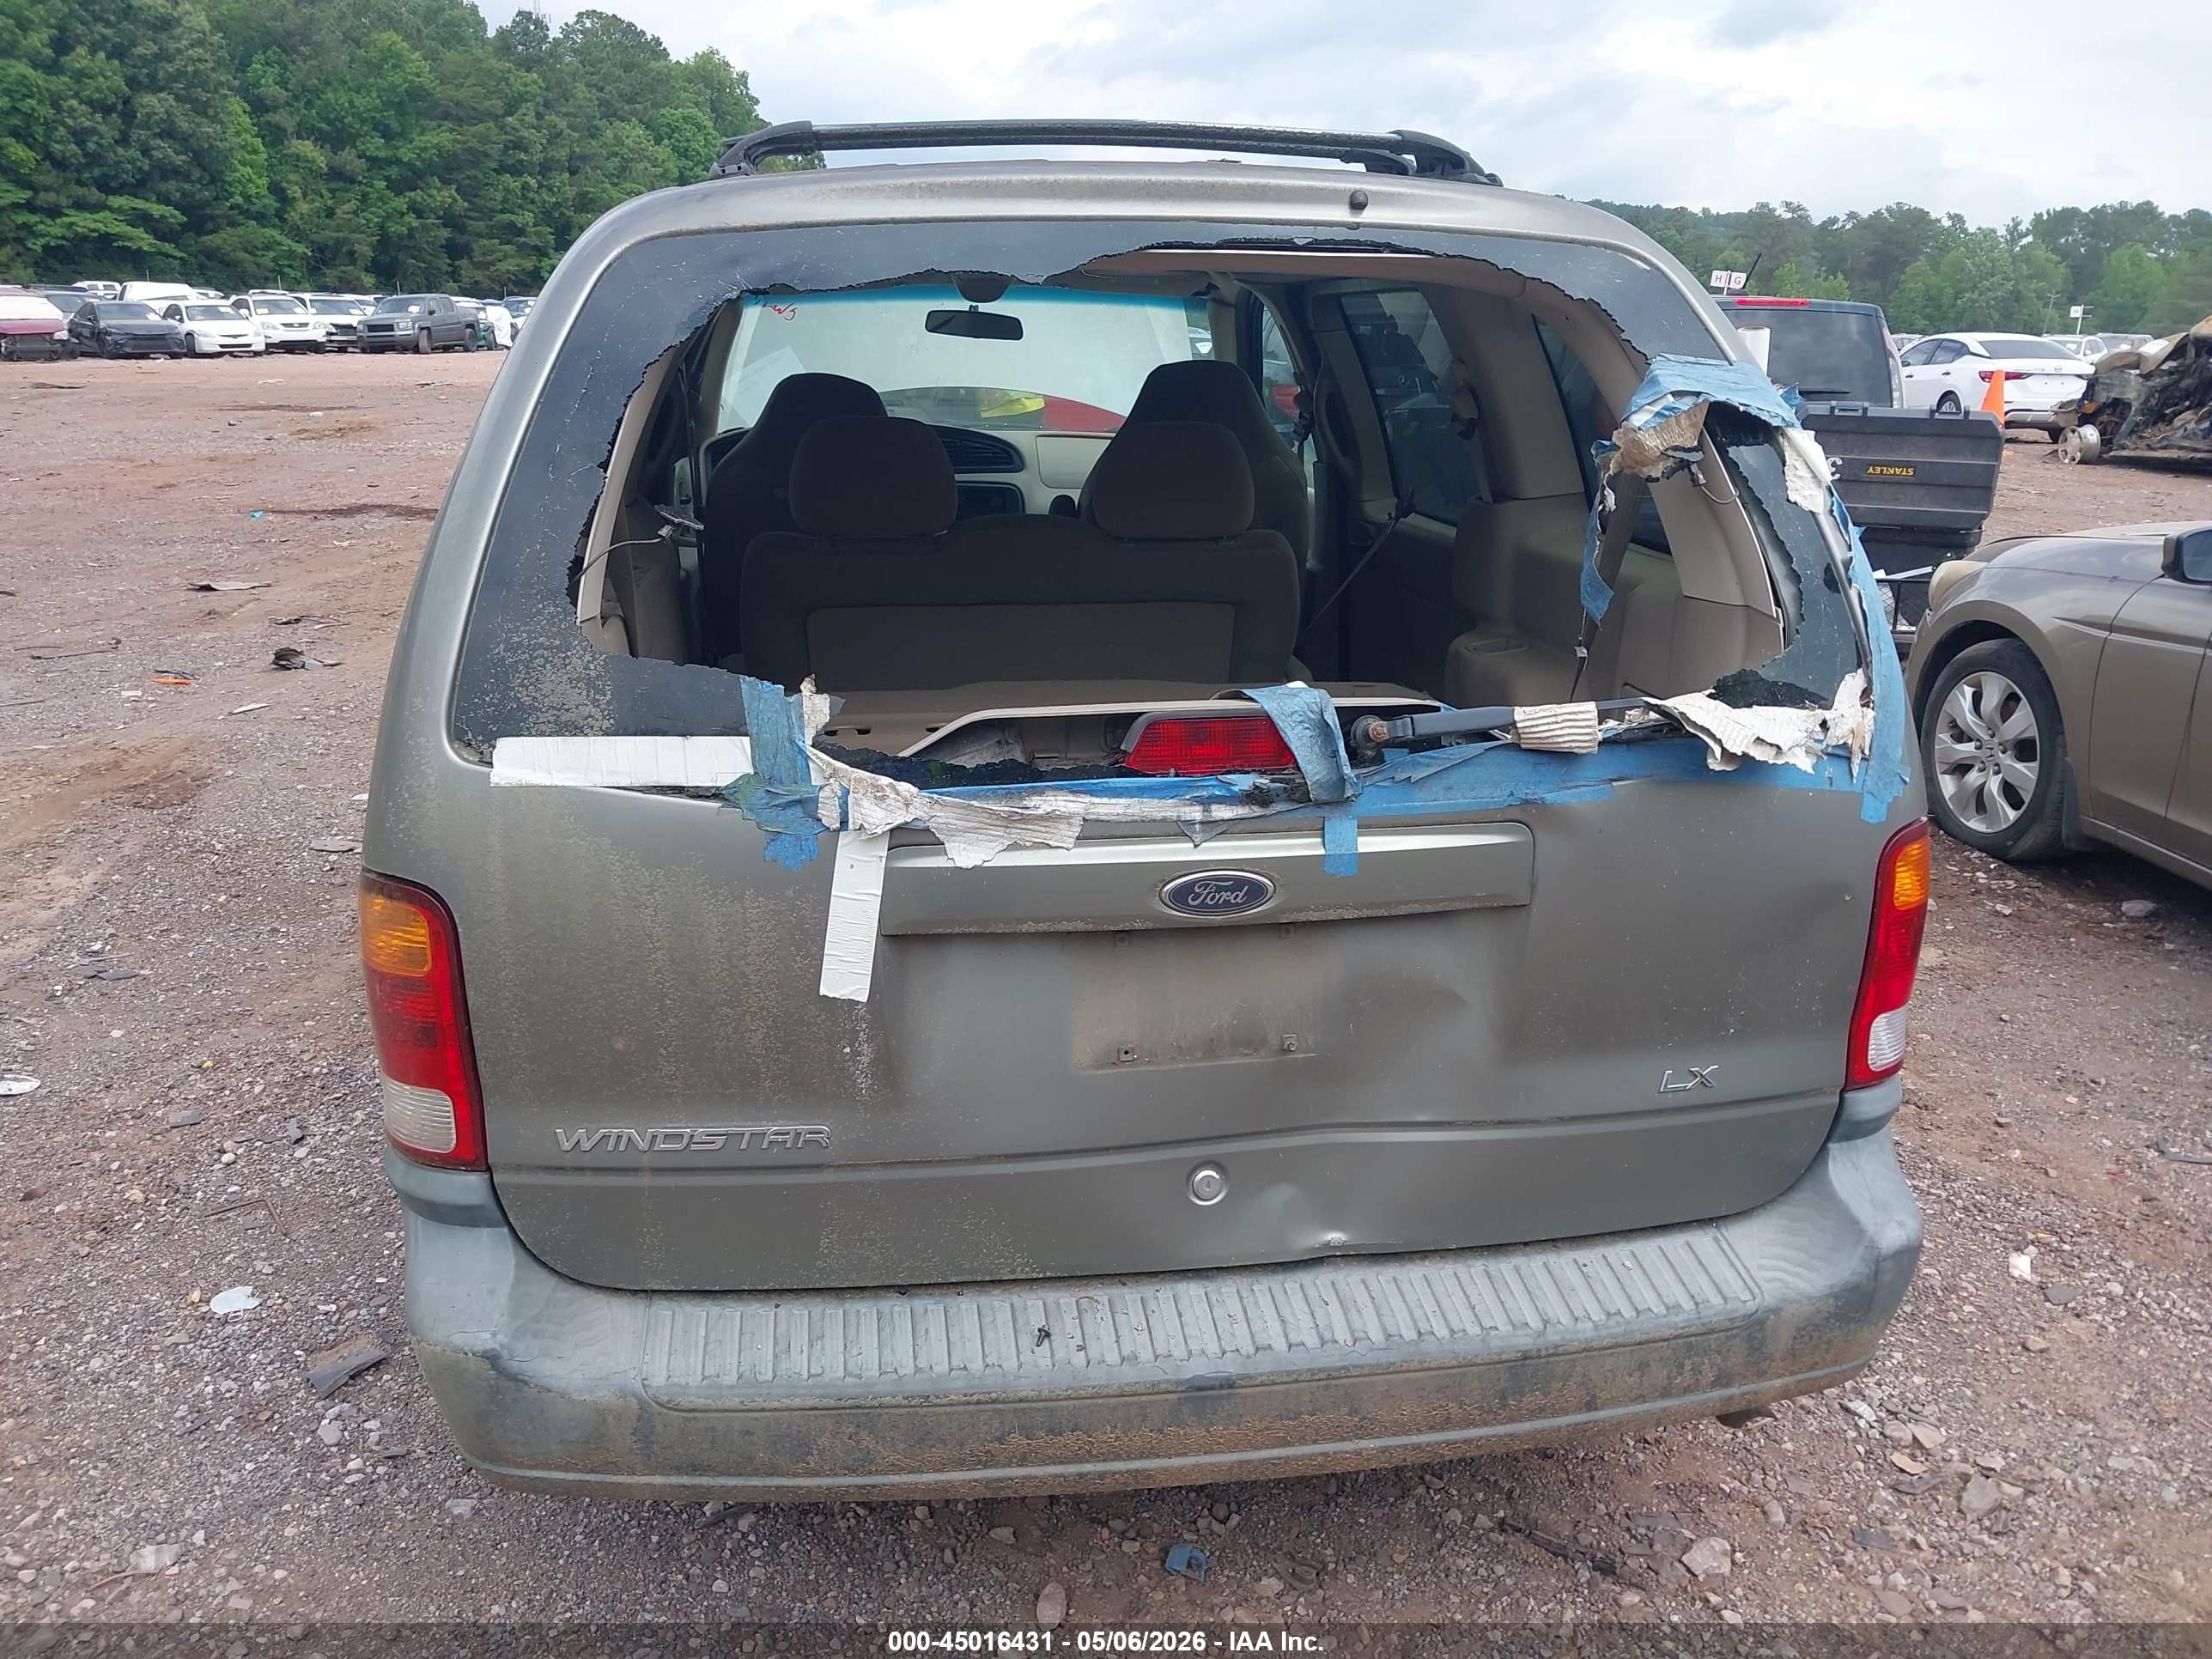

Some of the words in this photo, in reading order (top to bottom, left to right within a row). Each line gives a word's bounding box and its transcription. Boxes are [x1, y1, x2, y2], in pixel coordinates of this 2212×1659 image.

[1734, 276, 1742, 285] G
[1867, 465, 1915, 476] STANLEY
[1188, 879, 1249, 906] Ford
[1658, 1065, 1720, 1093] LX
[555, 1125, 831, 1152] WINDSTAR
